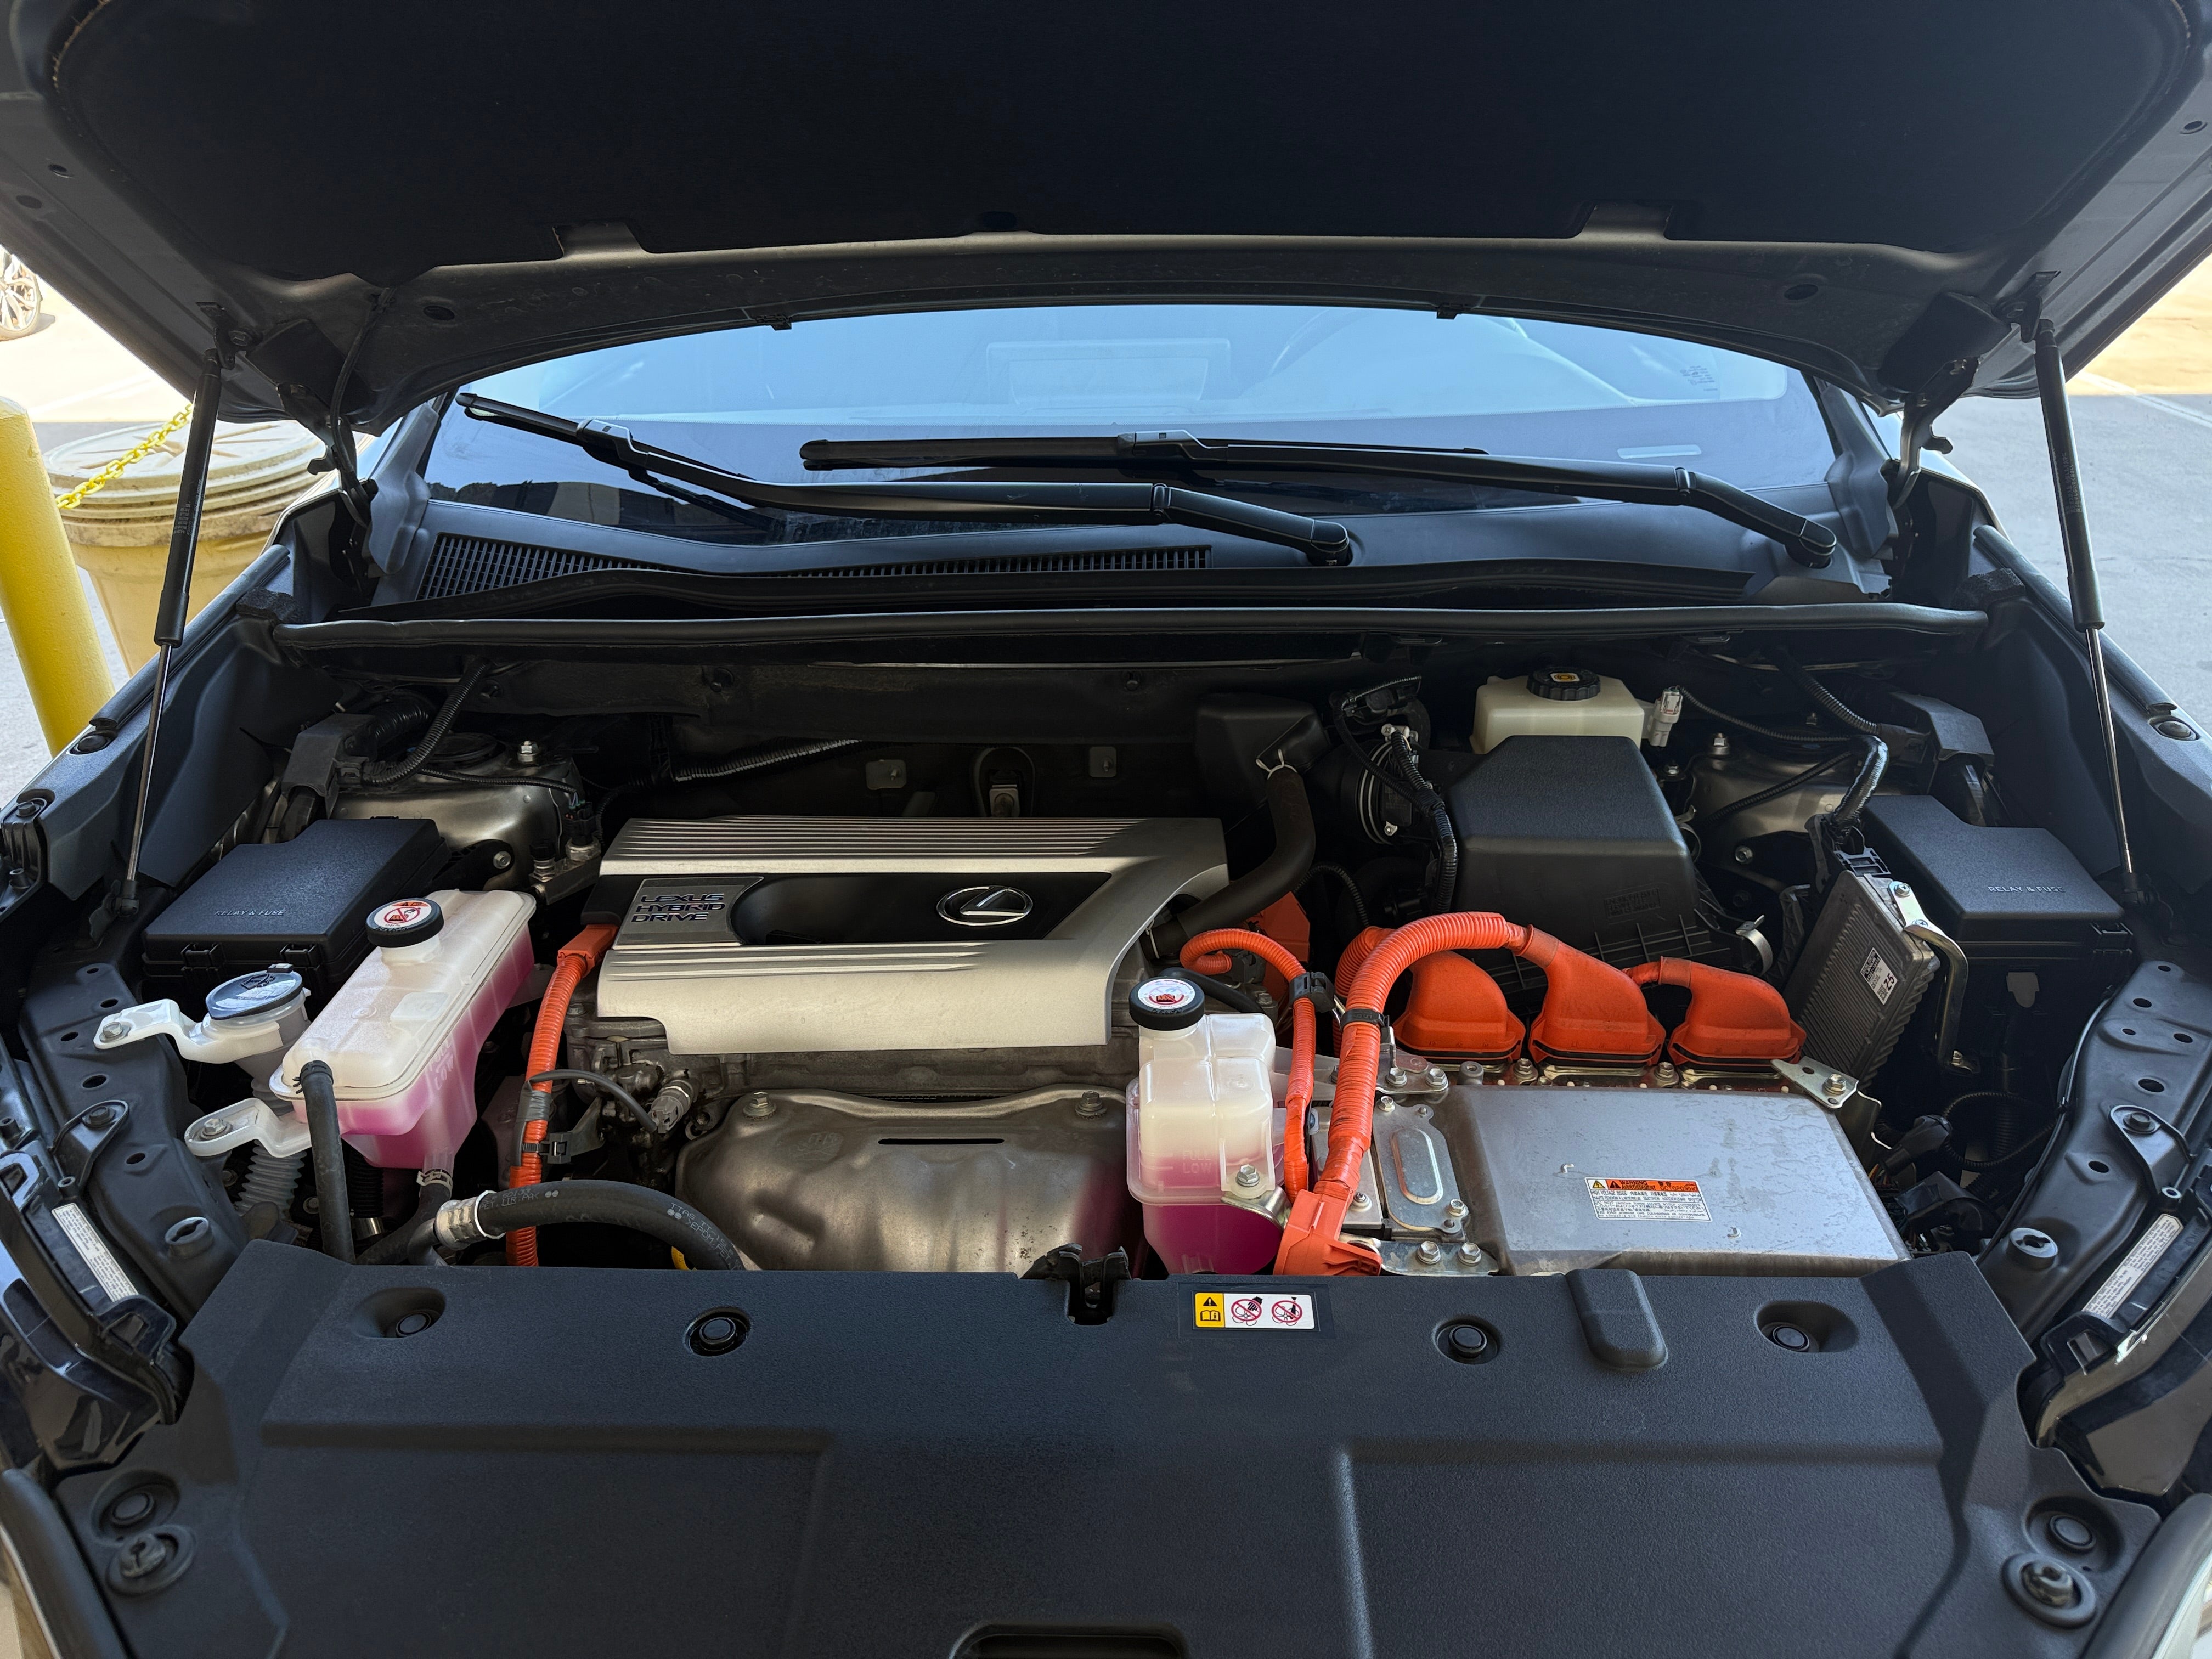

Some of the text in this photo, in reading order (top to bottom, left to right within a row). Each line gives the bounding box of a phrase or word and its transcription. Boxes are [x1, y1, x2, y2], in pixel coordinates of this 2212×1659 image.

[641, 893, 725, 902] LEXUS
[635, 902, 725, 912] HYBRID
[631, 912, 709, 922] DRIVE
[1182, 1150, 1211, 1160] FULL
[1182, 1163, 1212, 1173] LOW
[671, 1202, 696, 1221] TTAS
